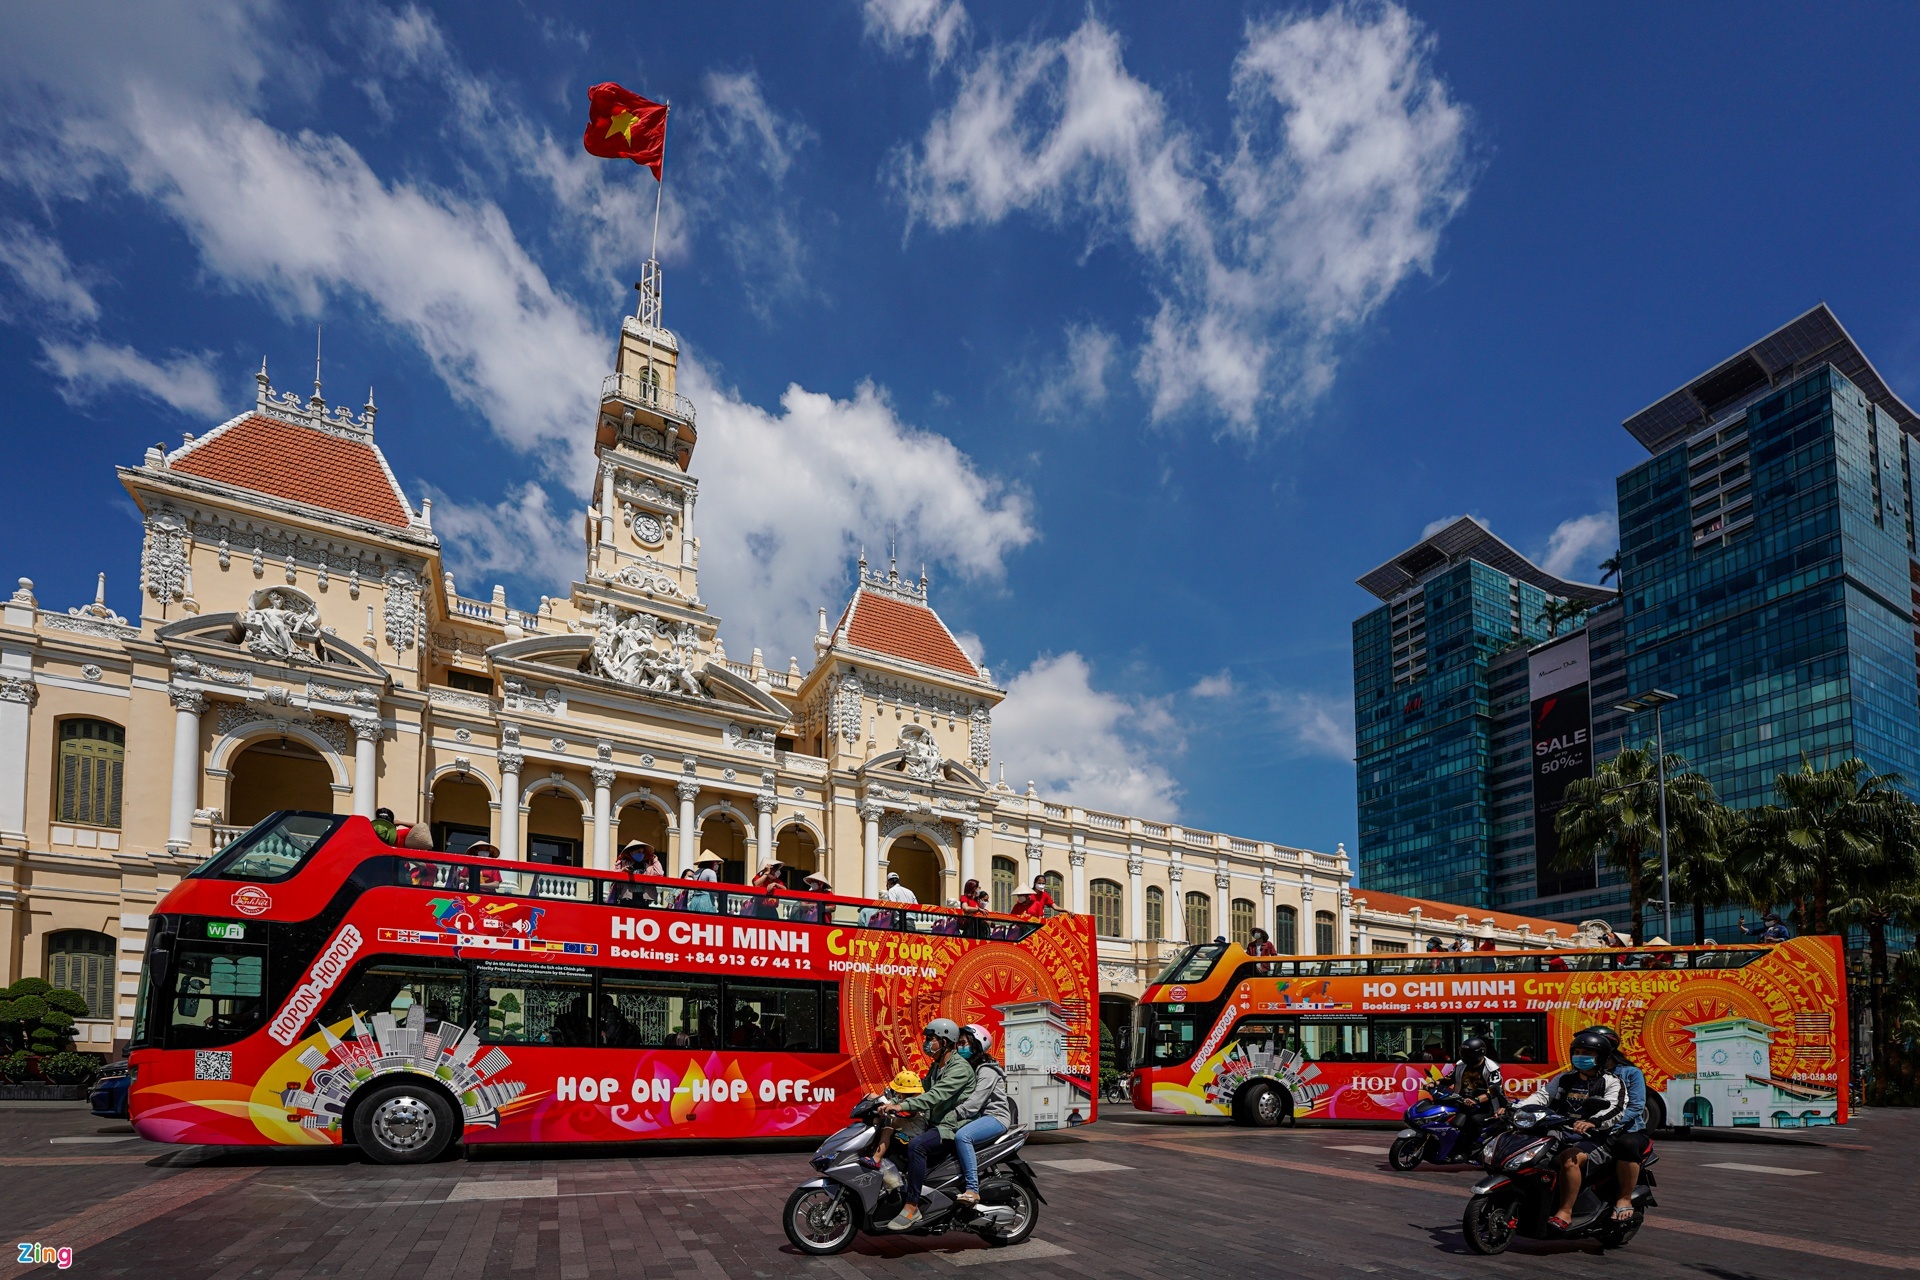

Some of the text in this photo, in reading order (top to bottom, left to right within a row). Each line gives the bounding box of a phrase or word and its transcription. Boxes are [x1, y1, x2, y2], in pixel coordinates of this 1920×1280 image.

[1536, 728, 1587, 756] SALE
[1541, 755, 1575, 774] 50%
[611, 916, 809, 953] HO CHI MINH
[611, 946, 811, 970] Booking: +84 913 67 44 12
[886, 942, 934, 961] TOUR
[829, 960, 937, 978] HOPON-HOPOFF.VN
[1363, 980, 1516, 998] HO CHI MINH
[1570, 980, 1681, 994] SIGHTSEEING
[1362, 1000, 1517, 1012] Booking: +84 913 67 44 12
[1526, 998, 1644, 1012] Hopon-hopoff.vn
[556, 1076, 620, 1103] HOP
[759, 1079, 835, 1103] OFF.VN
[1351, 1076, 1397, 1092] HOP
